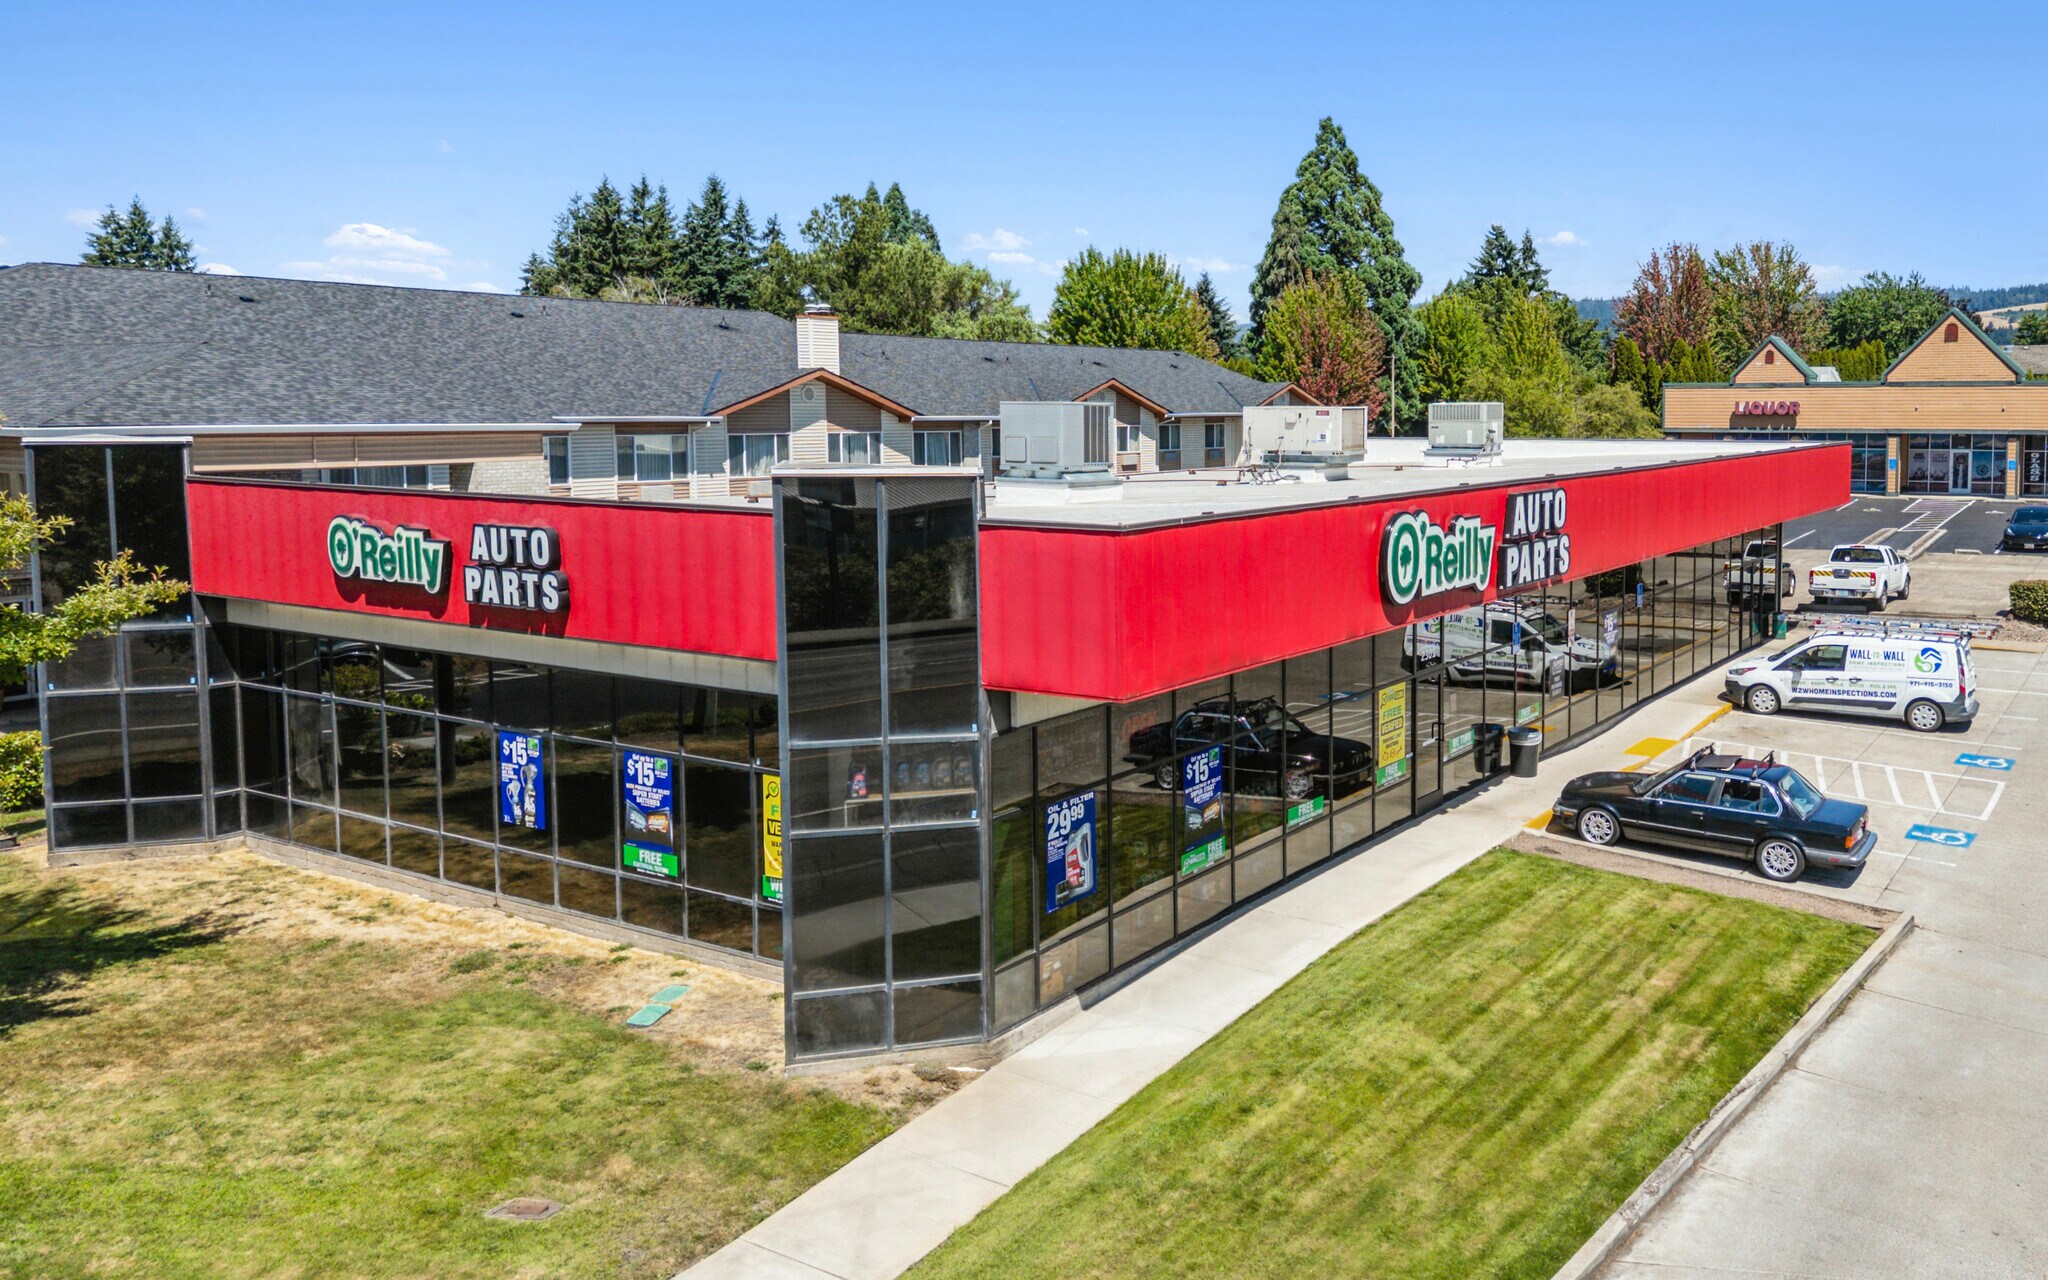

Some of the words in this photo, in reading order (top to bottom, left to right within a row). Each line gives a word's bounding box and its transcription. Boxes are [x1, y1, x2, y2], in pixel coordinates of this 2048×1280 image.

[1735, 401, 1800, 416] LIQUOR
[2029, 452, 2040, 482] GLASS
[1512, 489, 1566, 536] AUTO
[328, 516, 446, 593] O'Reilly
[471, 526, 550, 568] AUTO
[1388, 513, 1495, 603] O'Reilly
[1506, 535, 1570, 588] PARTS
[464, 565, 559, 612] PARTS
[1849, 648, 1871, 660] WALL
[1883, 650, 1905, 662] WALL
[1791, 687, 1898, 699] W2WHOMEINSPECTIONS.COM
[1382, 704, 1402, 720] FREE
[1381, 717, 1403, 735] VERIFIED
[502, 739, 528, 766] $15
[627, 758, 655, 787] $15
[1186, 757, 1209, 784] $15
[1385, 761, 1399, 777] FREE
[1047, 804, 1061, 815] OIL
[1061, 801, 1068, 809] &
[1069, 792, 1094, 807] FILTER
[1297, 800, 1315, 817] FREE
[639, 849, 662, 867] FREE
[1207, 838, 1223, 856] FREE
